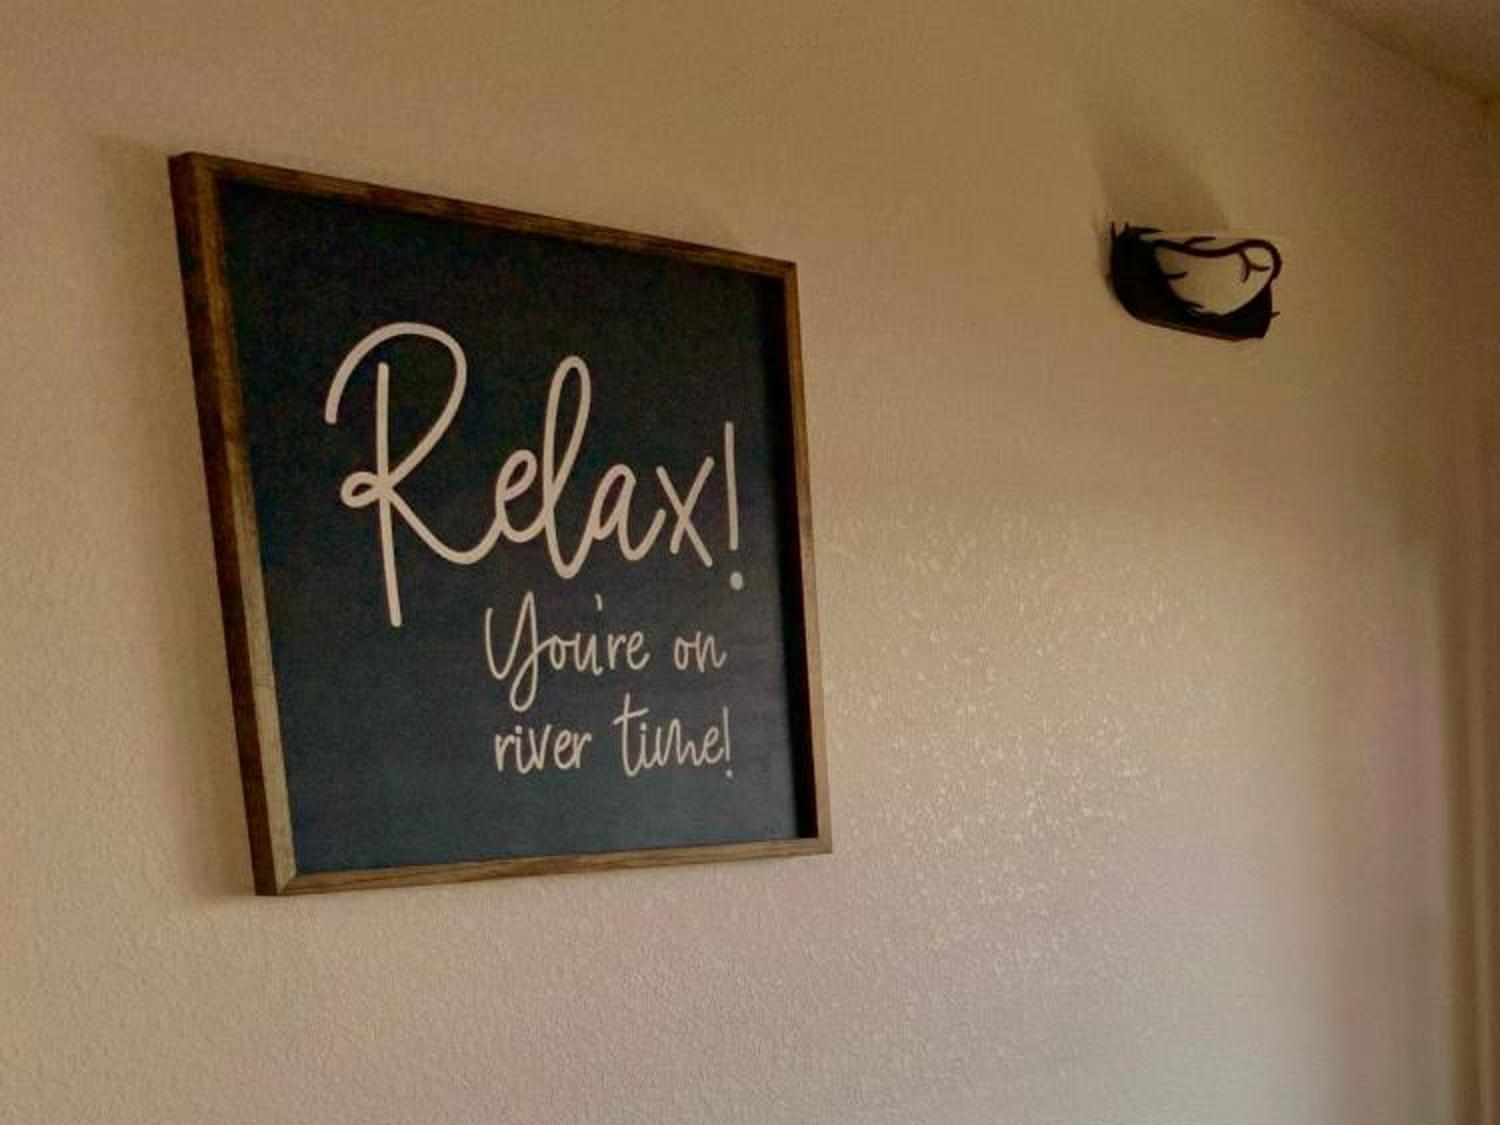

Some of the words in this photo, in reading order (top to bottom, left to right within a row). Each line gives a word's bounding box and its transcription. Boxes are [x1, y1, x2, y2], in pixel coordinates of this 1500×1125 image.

[324, 321, 745, 628] Relax!
[484, 591, 651, 714] You're
[672, 630, 728, 674] on
[494, 722, 594, 776] river
[612, 692, 733, 779] time!
